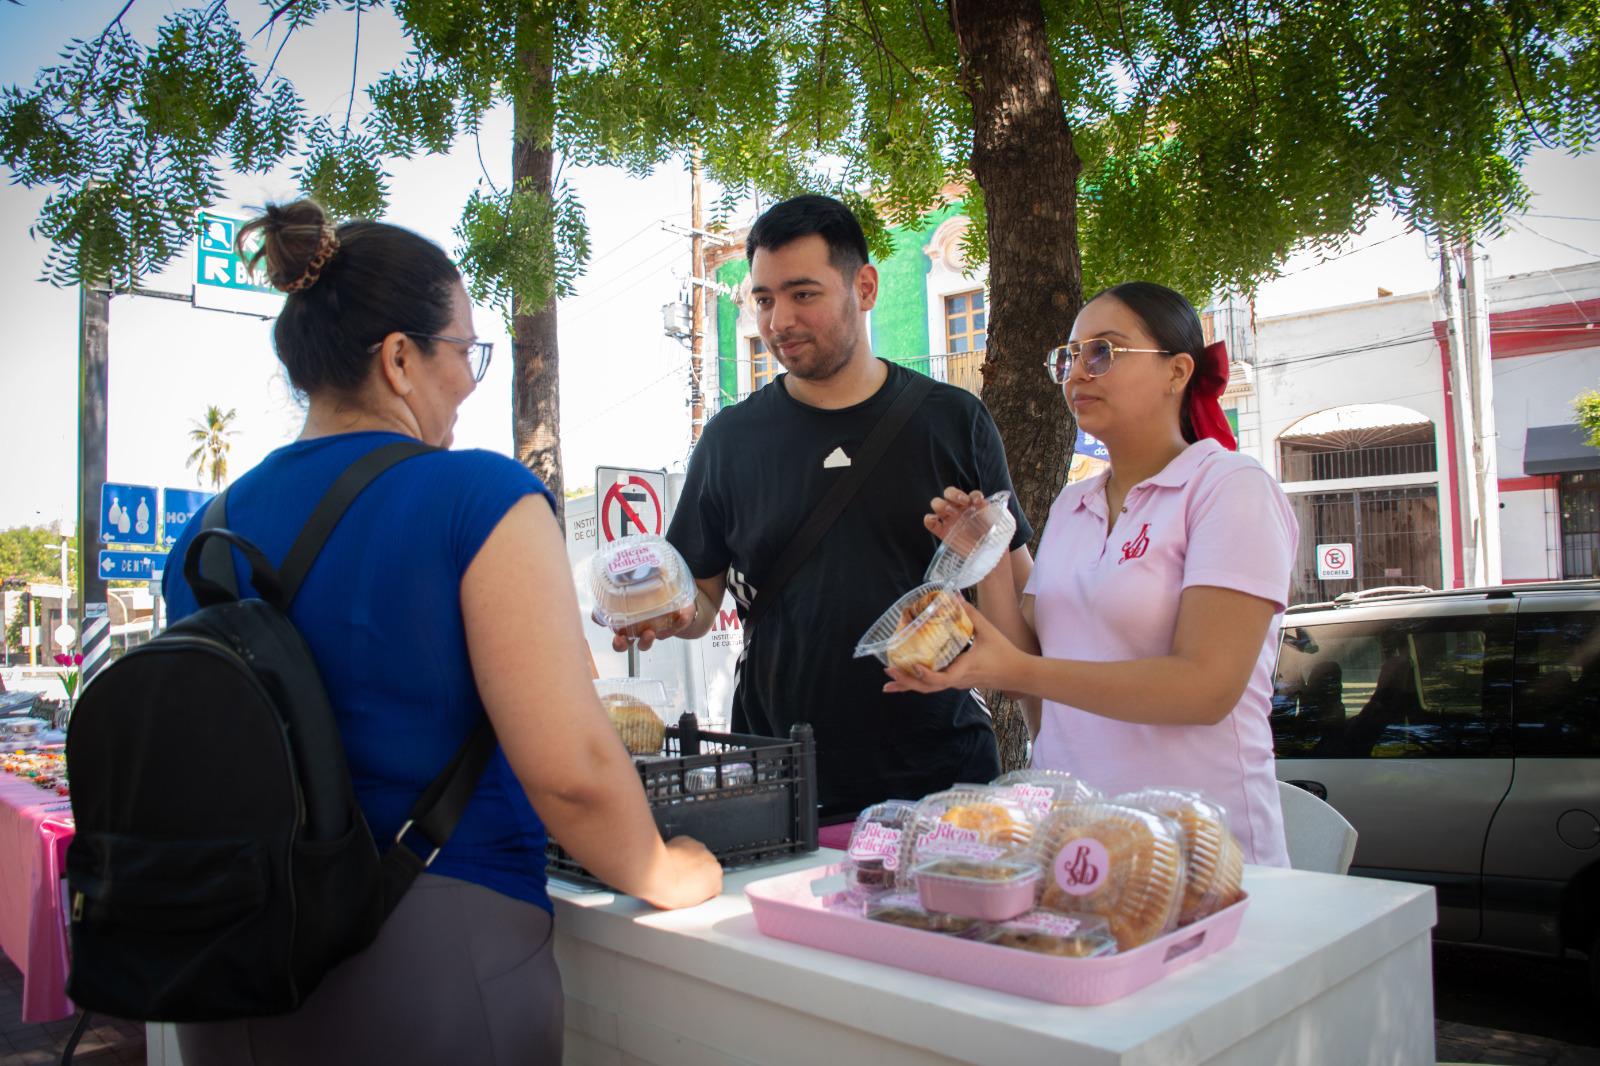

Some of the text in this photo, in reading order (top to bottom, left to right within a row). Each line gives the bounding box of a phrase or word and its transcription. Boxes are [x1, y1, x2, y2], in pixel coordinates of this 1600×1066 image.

[575, 532, 585, 541] DE
[860, 822, 898, 840] Ricas
[929, 822, 977, 842] Ricas
